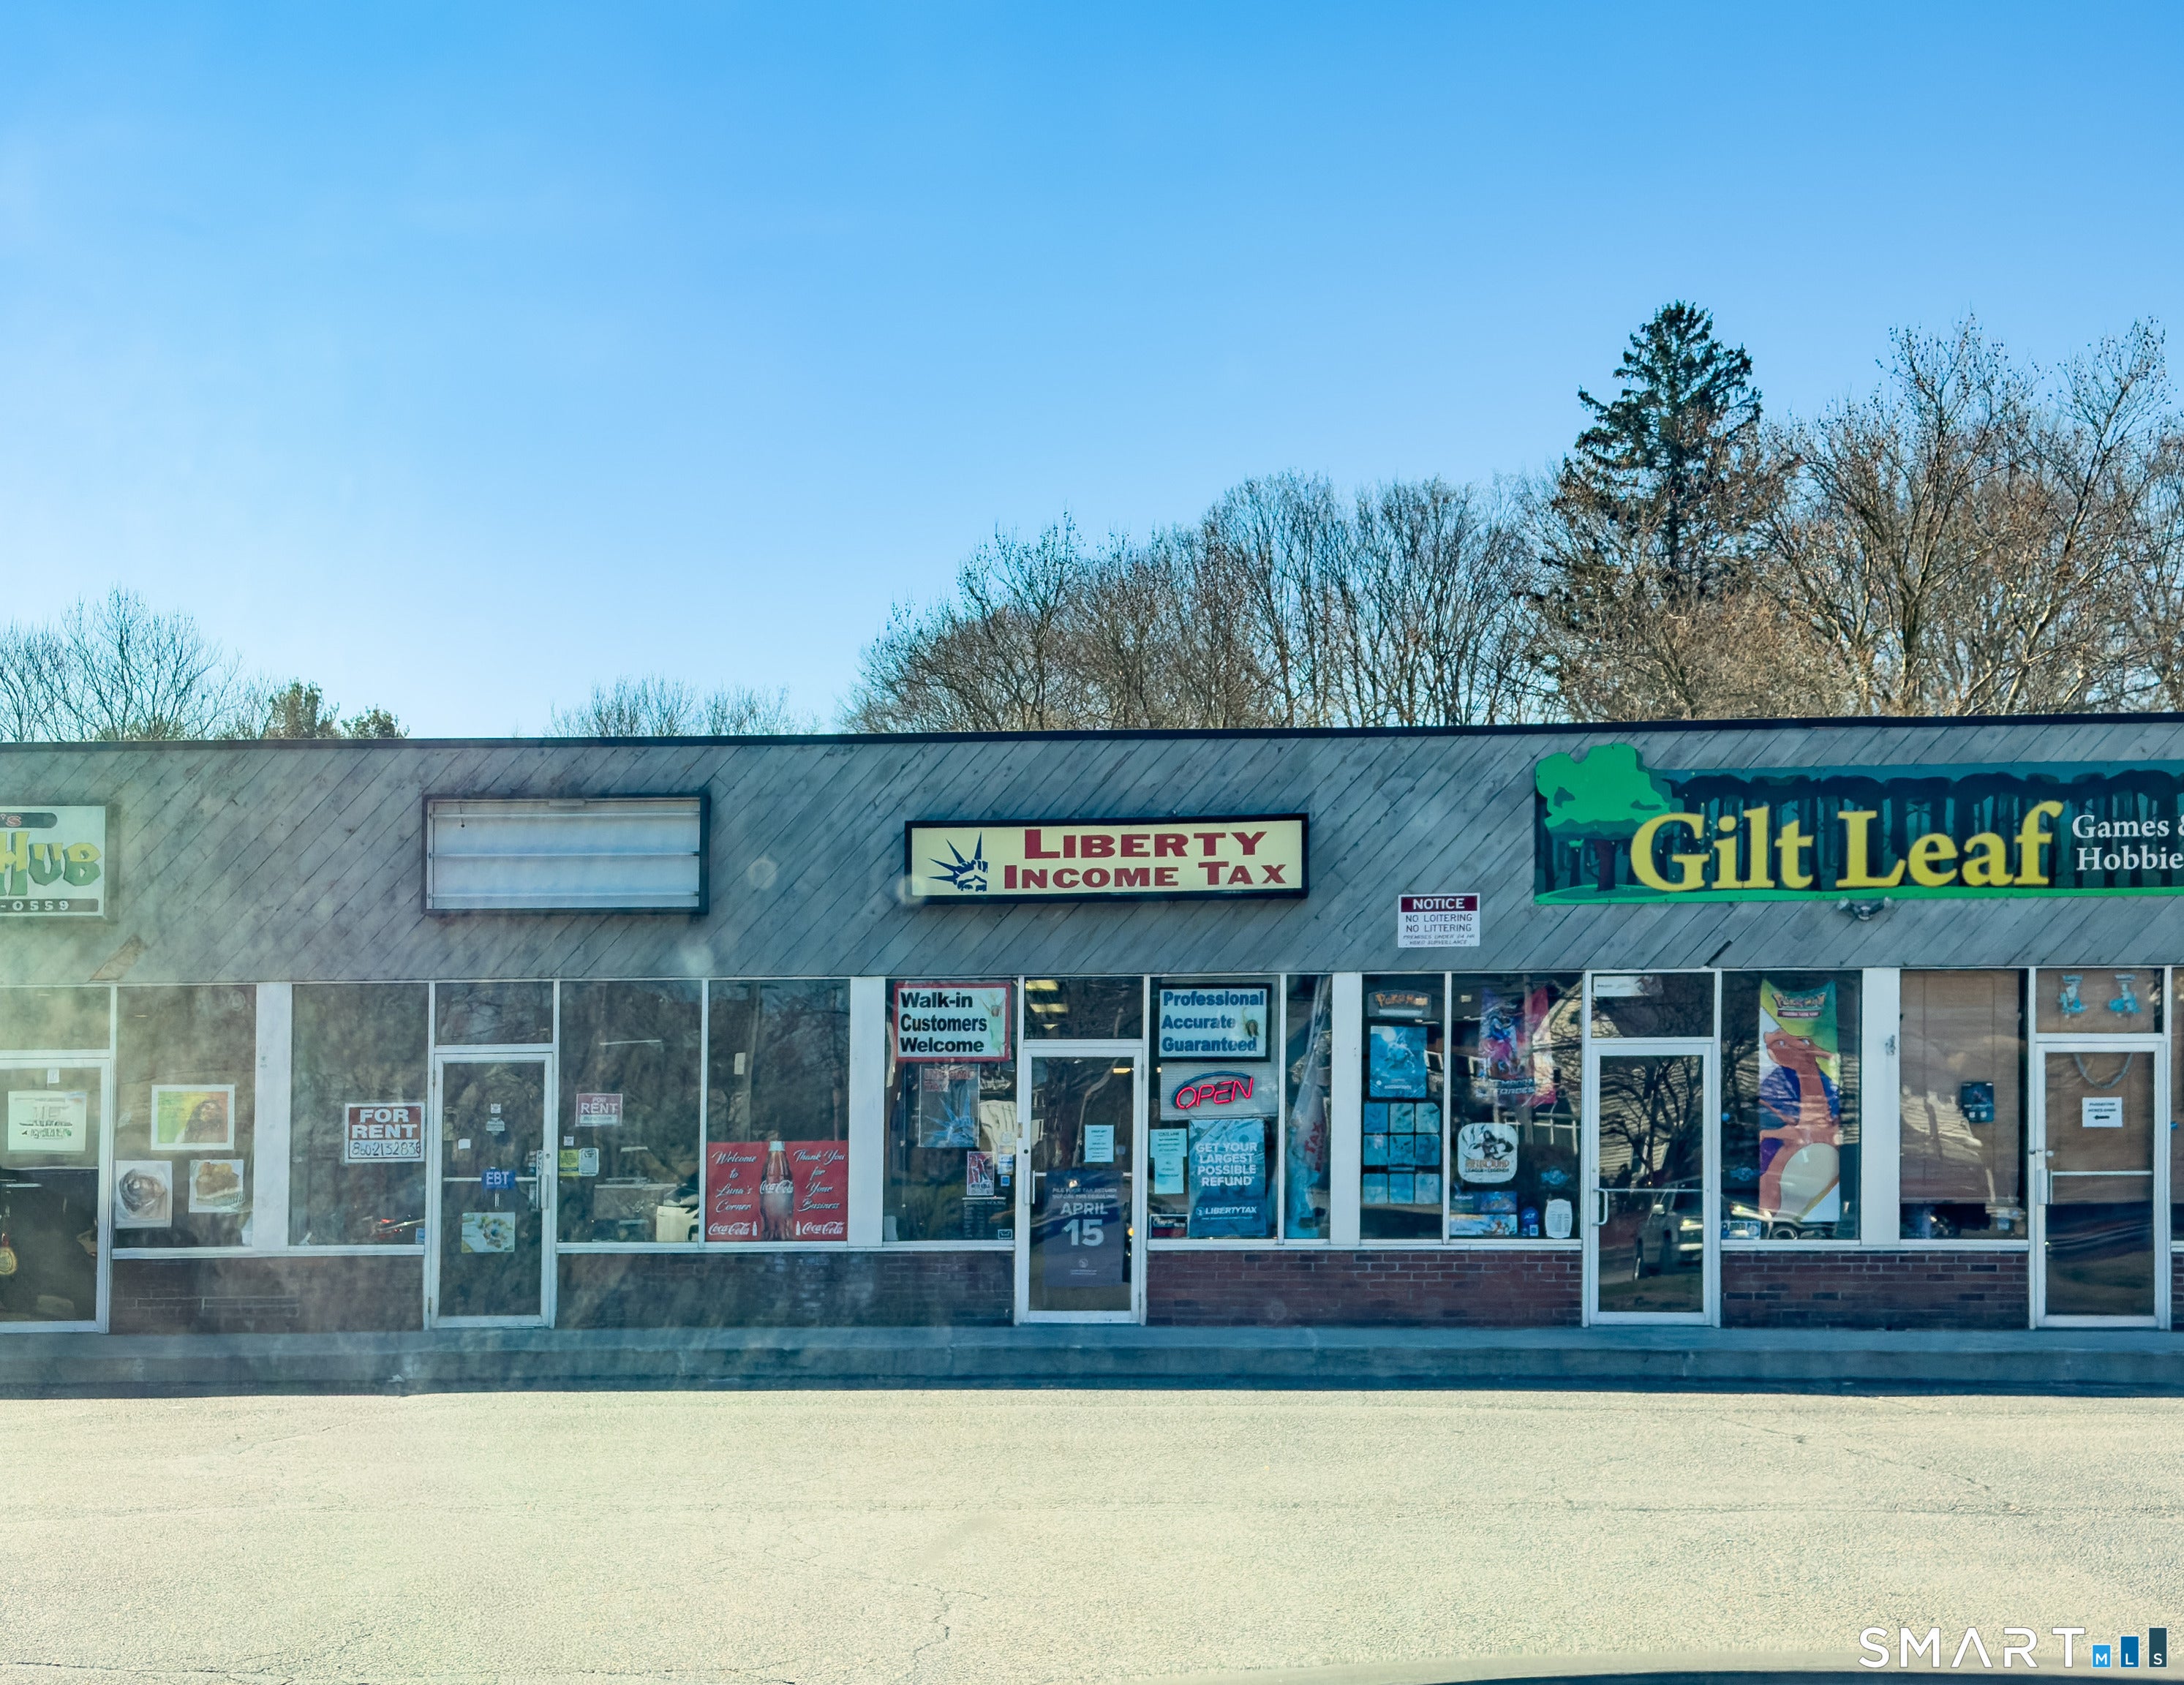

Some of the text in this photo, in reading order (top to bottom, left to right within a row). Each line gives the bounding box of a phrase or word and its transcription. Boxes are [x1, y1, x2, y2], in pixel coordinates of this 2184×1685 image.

[2072, 814, 2170, 839] Games
[1025, 829, 1268, 859] LIBERTY
[1630, 800, 2063, 892] Gilt Leaf
[2076, 843, 2184, 872] Hobbie
[1004, 860, 1287, 889] INCOME TAX
[1412, 898, 1465, 910] NOTICE
[1406, 913, 1473, 922] NO LOITERING
[1406, 923, 1472, 932] NO LITTERING
[900, 992, 973, 1009] Walk-in
[1164, 991, 1265, 1006] Professional
[900, 1014, 987, 1032] Customers
[1161, 1015, 1236, 1029] Accurate
[900, 1037, 984, 1052] Welcome
[1162, 1037, 1257, 1052] Guaranteed
[1176, 1077, 1254, 1110] OPEN
[359, 1108, 410, 1123] FOR
[581, 1103, 618, 1114] RENT
[352, 1124, 418, 1139] RENT
[1195, 1142, 1257, 1153] GET YOUR
[712, 1150, 757, 1164] Welcome
[793, 1149, 846, 1165] Thank You
[1200, 1153, 1254, 1164] LARGEST
[729, 1167, 739, 1179] to
[810, 1166, 826, 1181] for
[1197, 1164, 1257, 1175] POSSIBLE
[486, 1171, 510, 1185] EBT
[716, 1183, 753, 1198] Luna's
[805, 1181, 834, 1197] Your
[715, 1199, 752, 1213] Corner
[797, 1198, 840, 1213] Business
[1060, 1202, 1108, 1215] APRIL
[1063, 1218, 1105, 1247] 15
